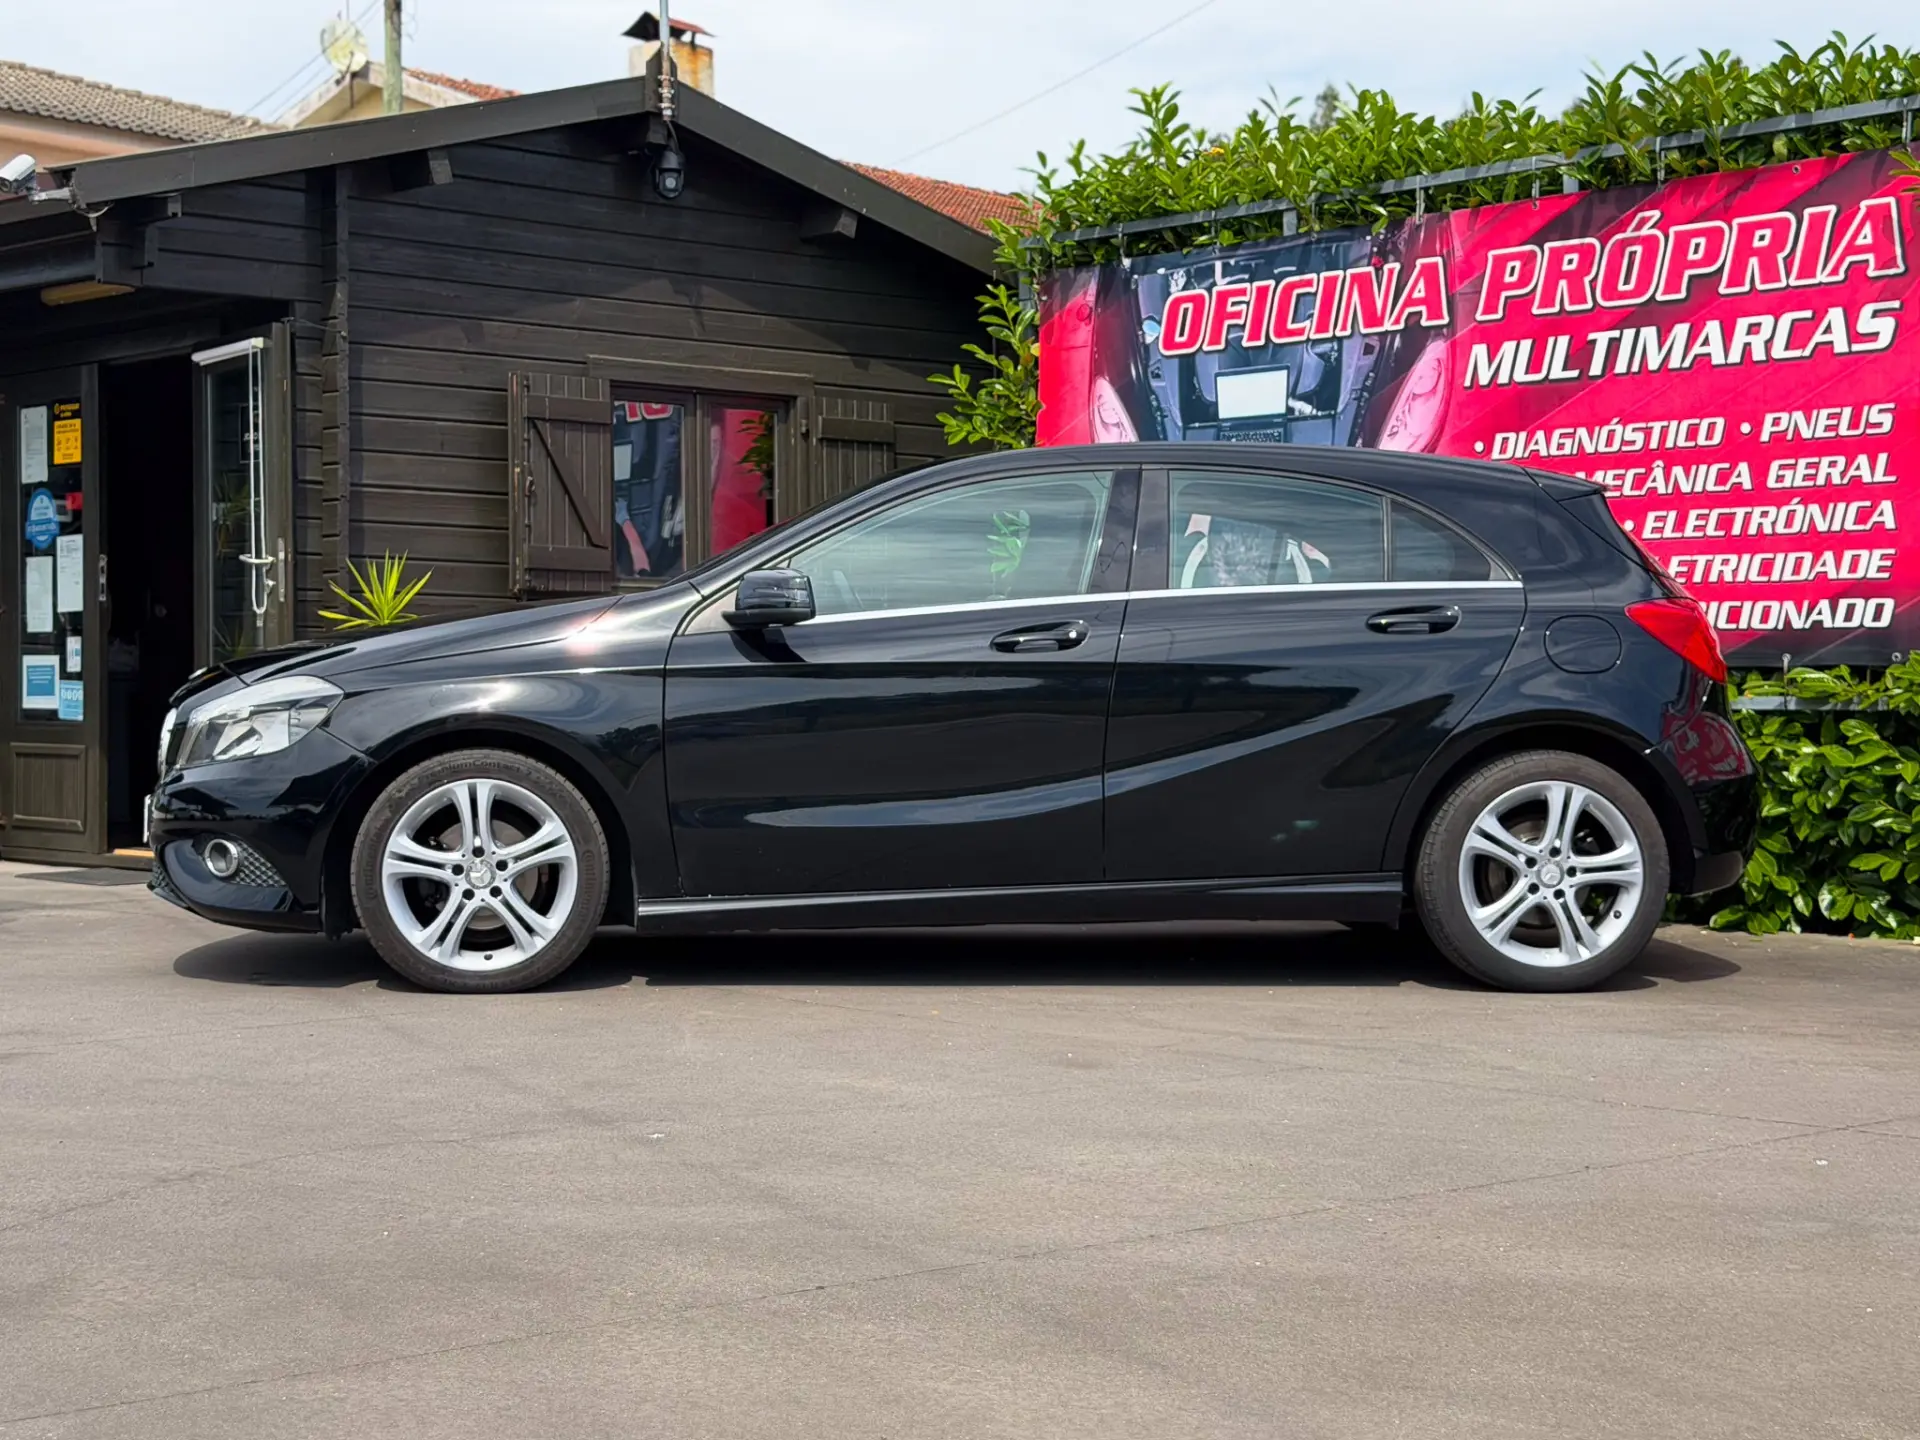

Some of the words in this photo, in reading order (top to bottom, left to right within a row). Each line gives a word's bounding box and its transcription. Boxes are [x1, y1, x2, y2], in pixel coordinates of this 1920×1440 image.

[1158, 256, 1450, 356] OFICINA
[1475, 196, 1906, 322] PRÓPRIA
[1463, 300, 1901, 388] MULTIMARCAS
[1491, 417, 1725, 461] DIAGNÓSTICO
[1760, 402, 1896, 443] PNEUS
[1766, 452, 1898, 490] GERAL
[1641, 497, 1897, 540] ELECTRÓNICA
[1655, 548, 1896, 585] ETRICIDADE
[1699, 597, 1895, 631] ICIONADO
